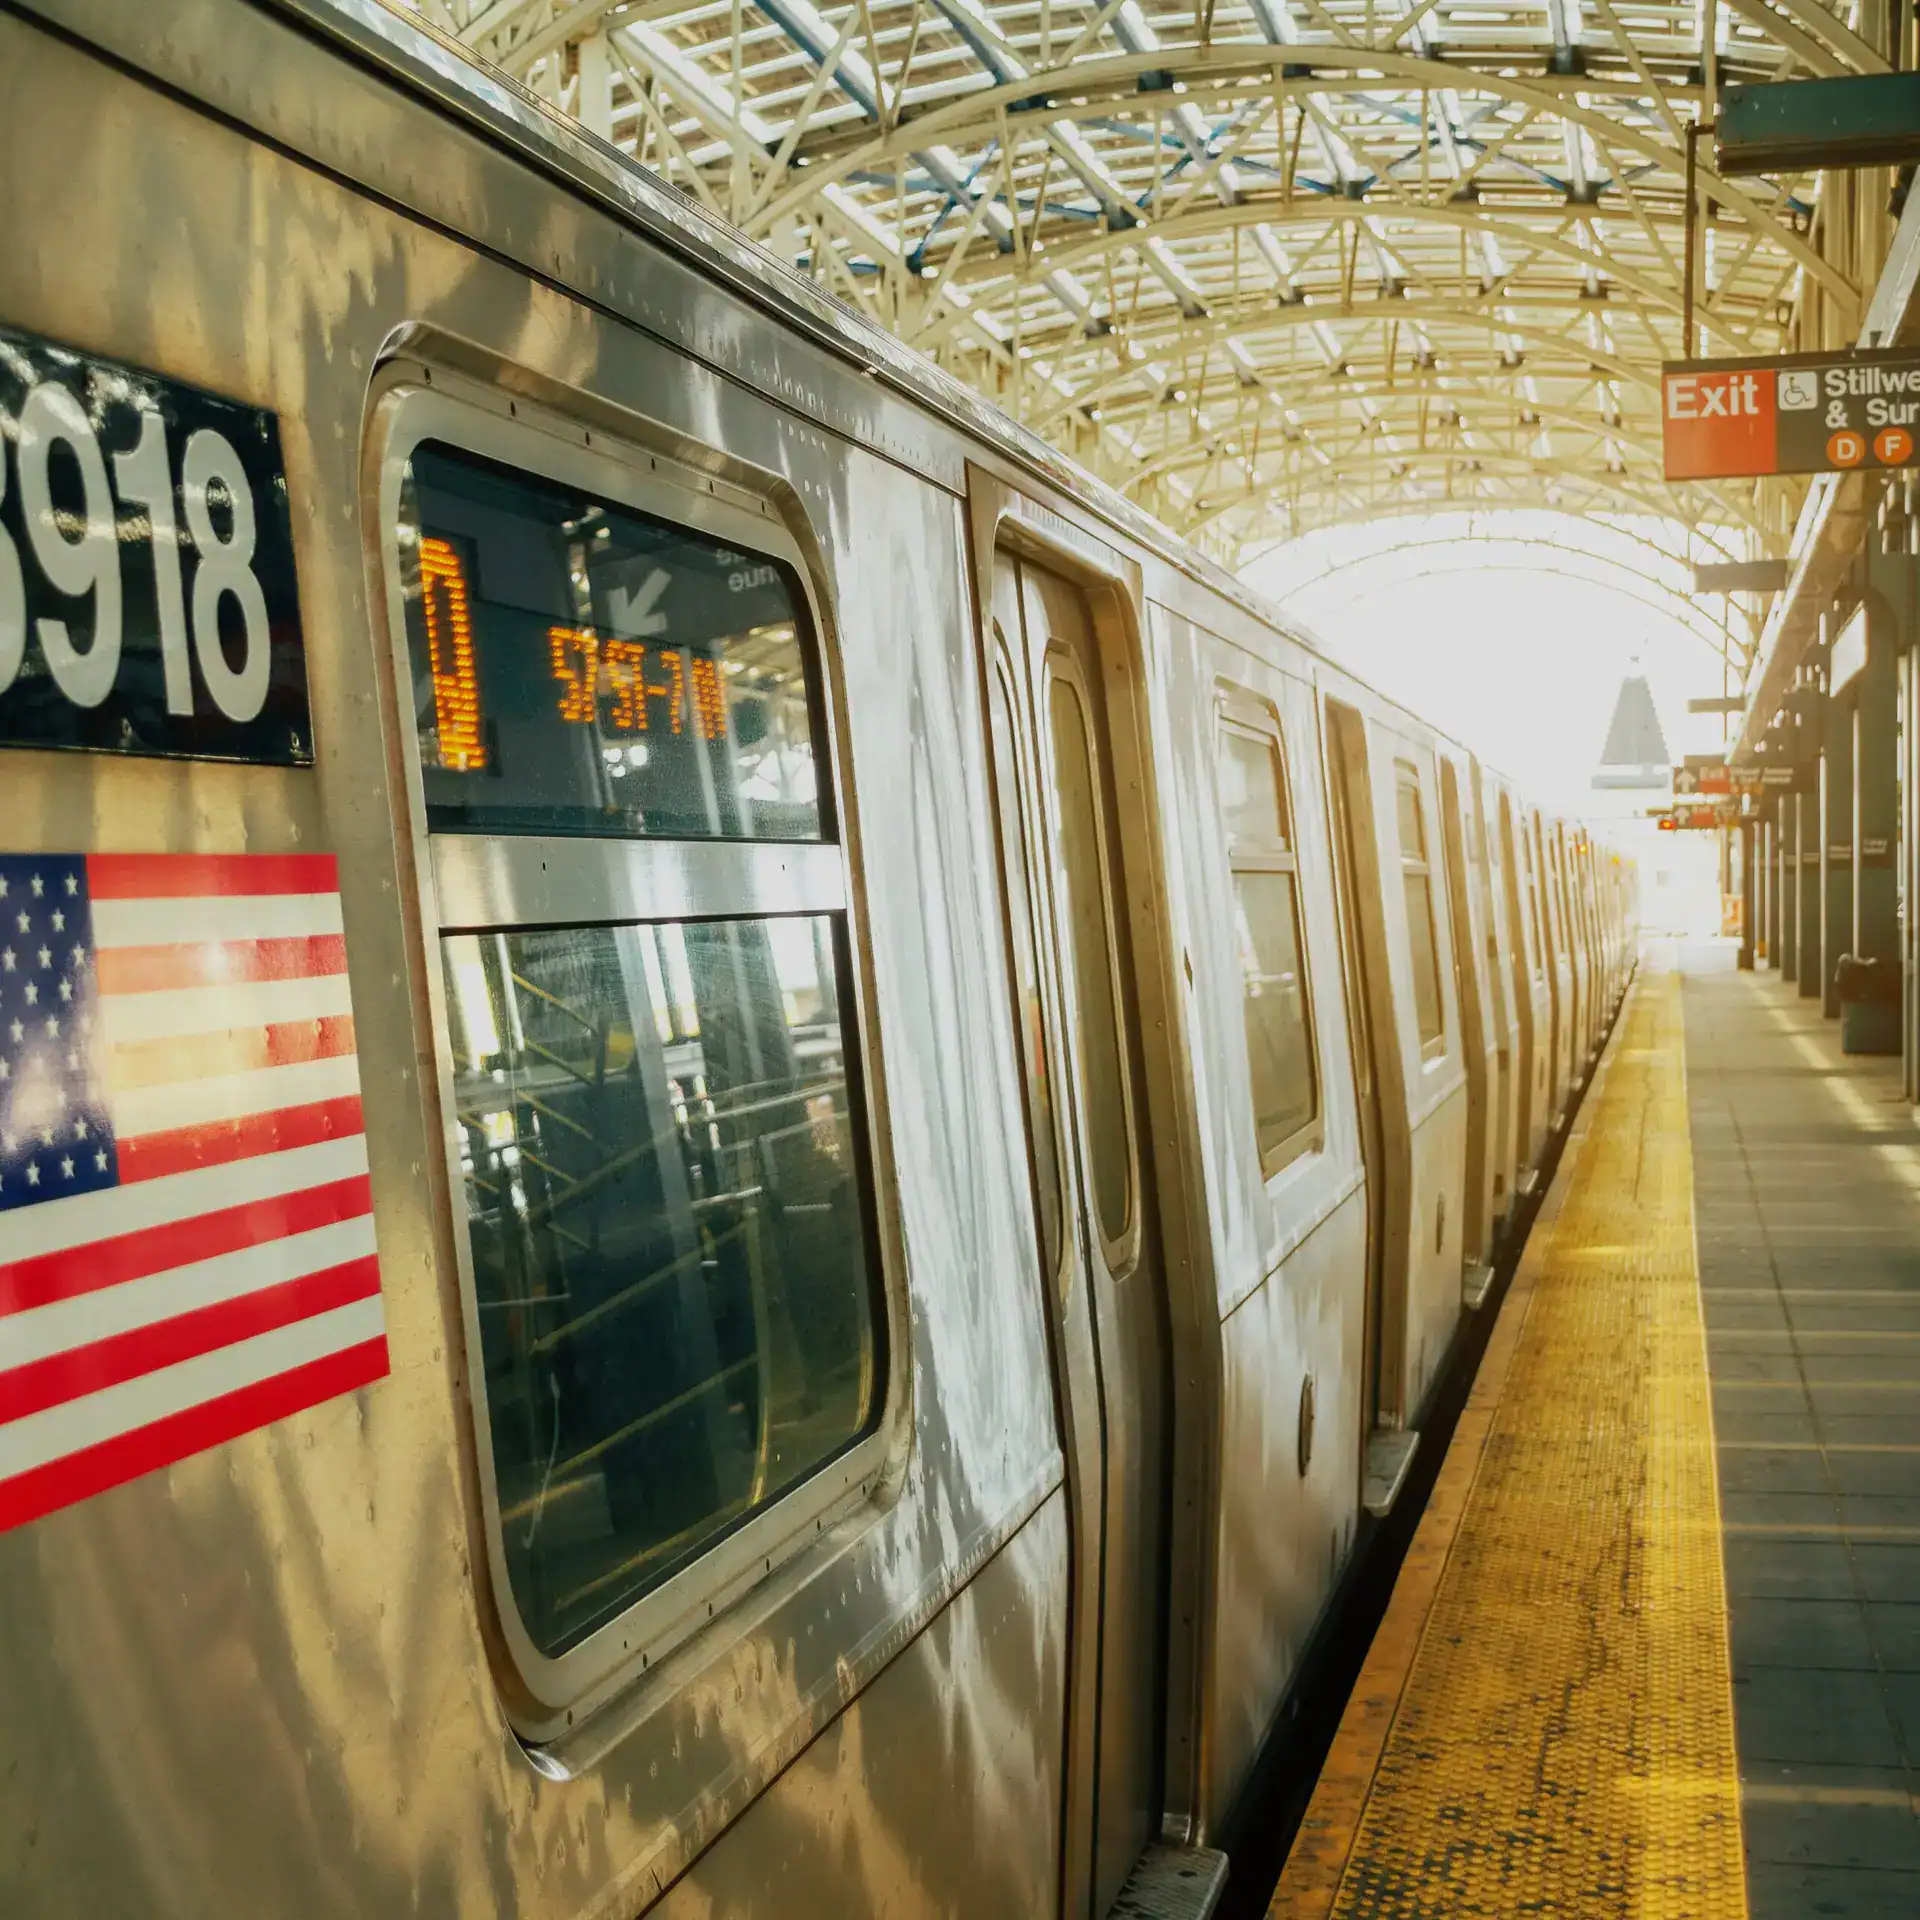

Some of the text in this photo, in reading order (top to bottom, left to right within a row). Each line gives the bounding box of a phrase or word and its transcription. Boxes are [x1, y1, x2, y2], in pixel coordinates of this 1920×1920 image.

[1667, 375, 1760, 419] Exit
[1824, 366, 1920, 397] Stillwe
[1825, 398, 1920, 429] & Sur
[1837, 435, 1903, 460] D F
